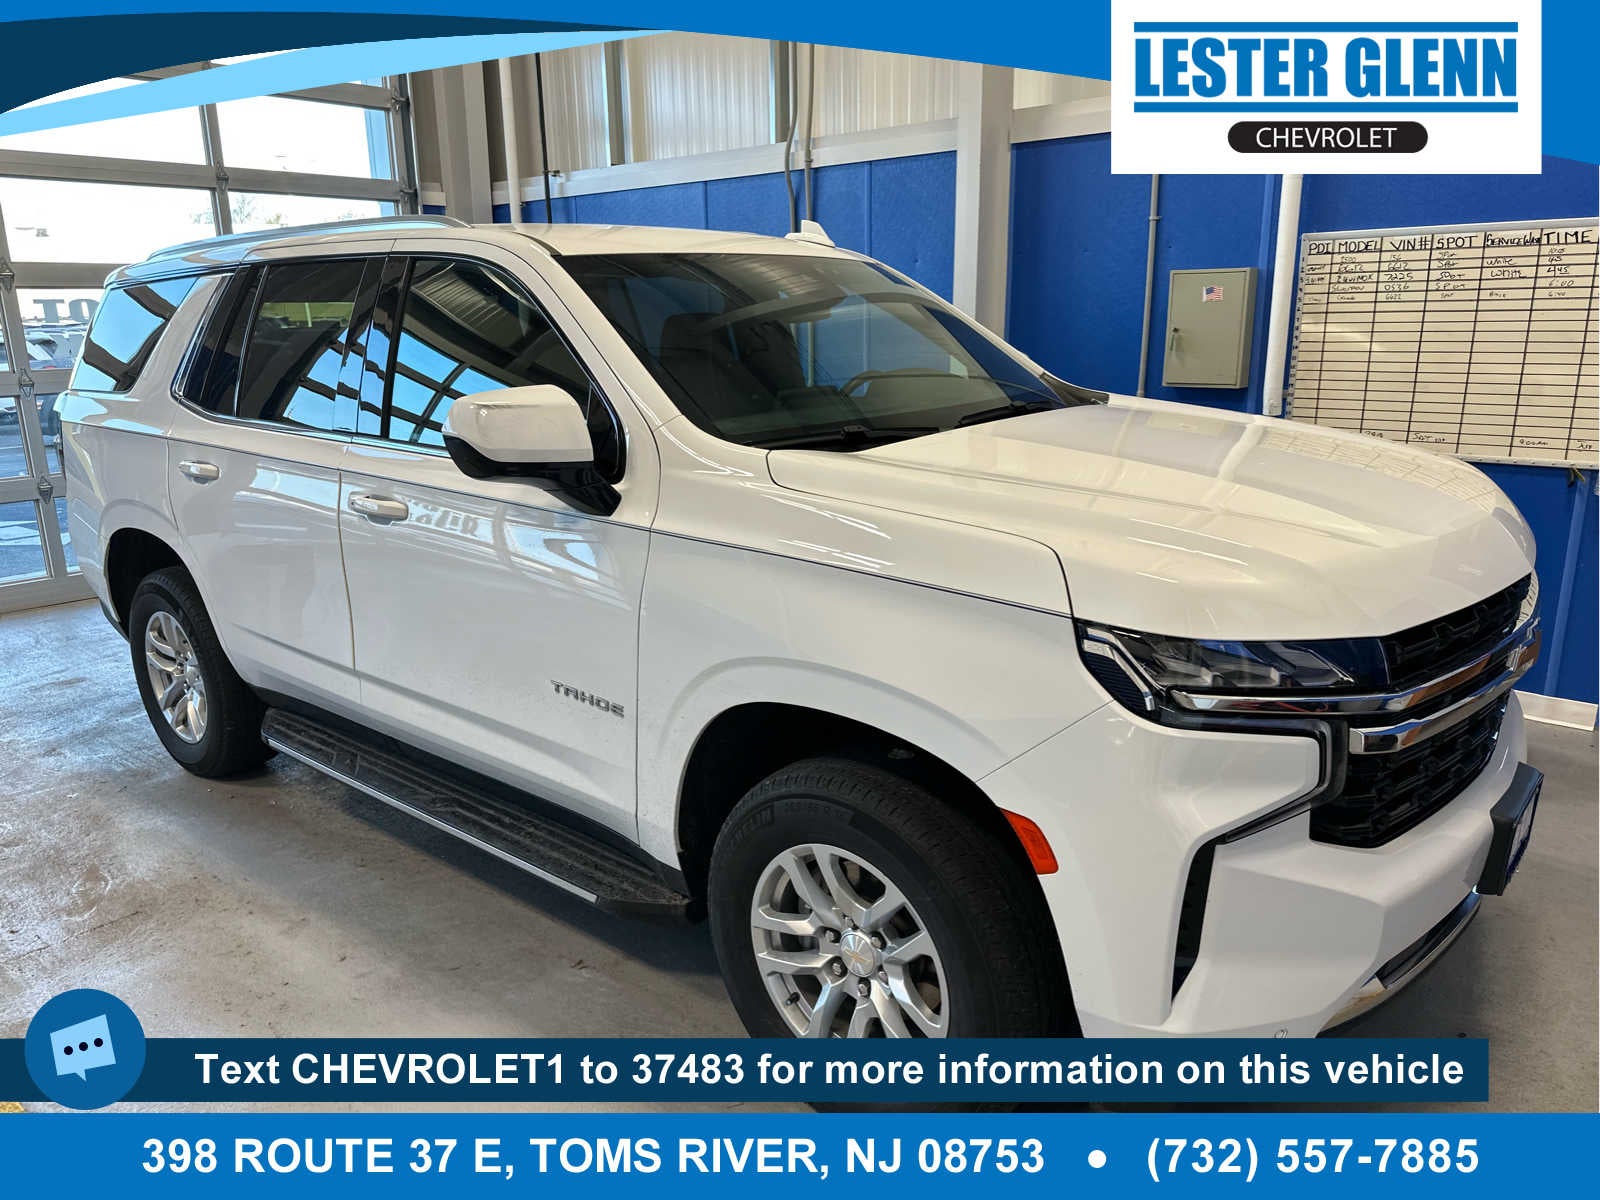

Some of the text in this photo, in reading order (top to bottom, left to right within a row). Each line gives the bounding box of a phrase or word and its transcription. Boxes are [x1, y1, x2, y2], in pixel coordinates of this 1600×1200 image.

[1436, 235, 1479, 248] SPOT
[1543, 230, 1593, 244] TIME
[1338, 240, 1380, 252] MODEL
[550, 679, 625, 719] TAHOE
